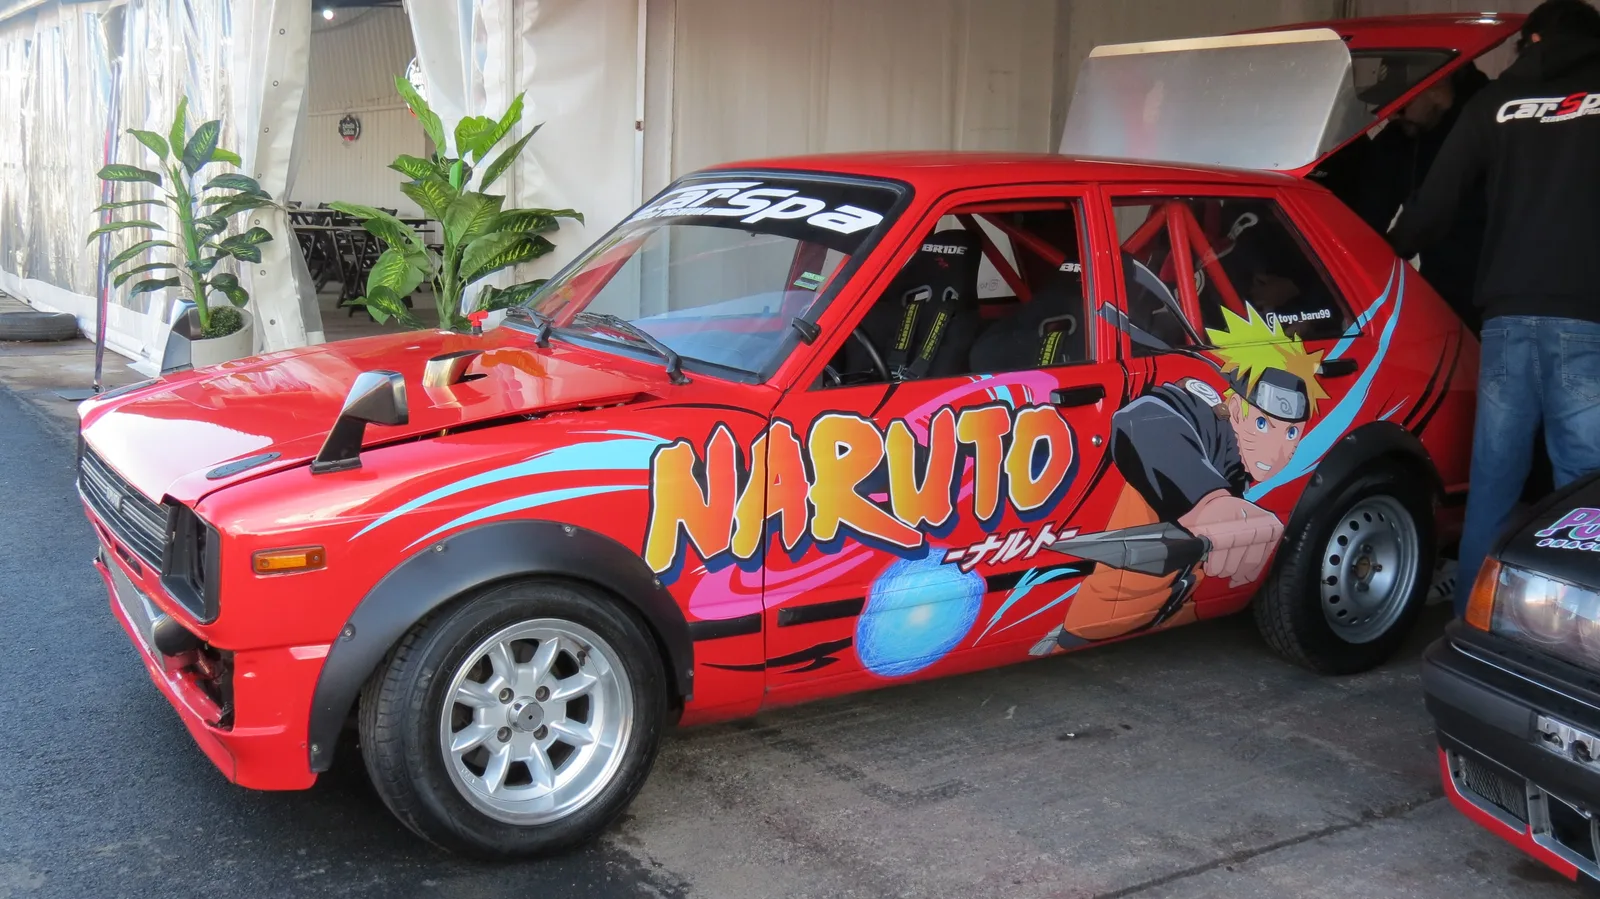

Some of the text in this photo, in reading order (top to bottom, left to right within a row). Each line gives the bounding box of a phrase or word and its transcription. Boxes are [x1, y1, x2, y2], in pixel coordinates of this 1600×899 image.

[921, 243, 968, 255] BRIDE
[1278, 308, 1331, 325] toyo_baru99
[643, 403, 1076, 577] NARUTO
